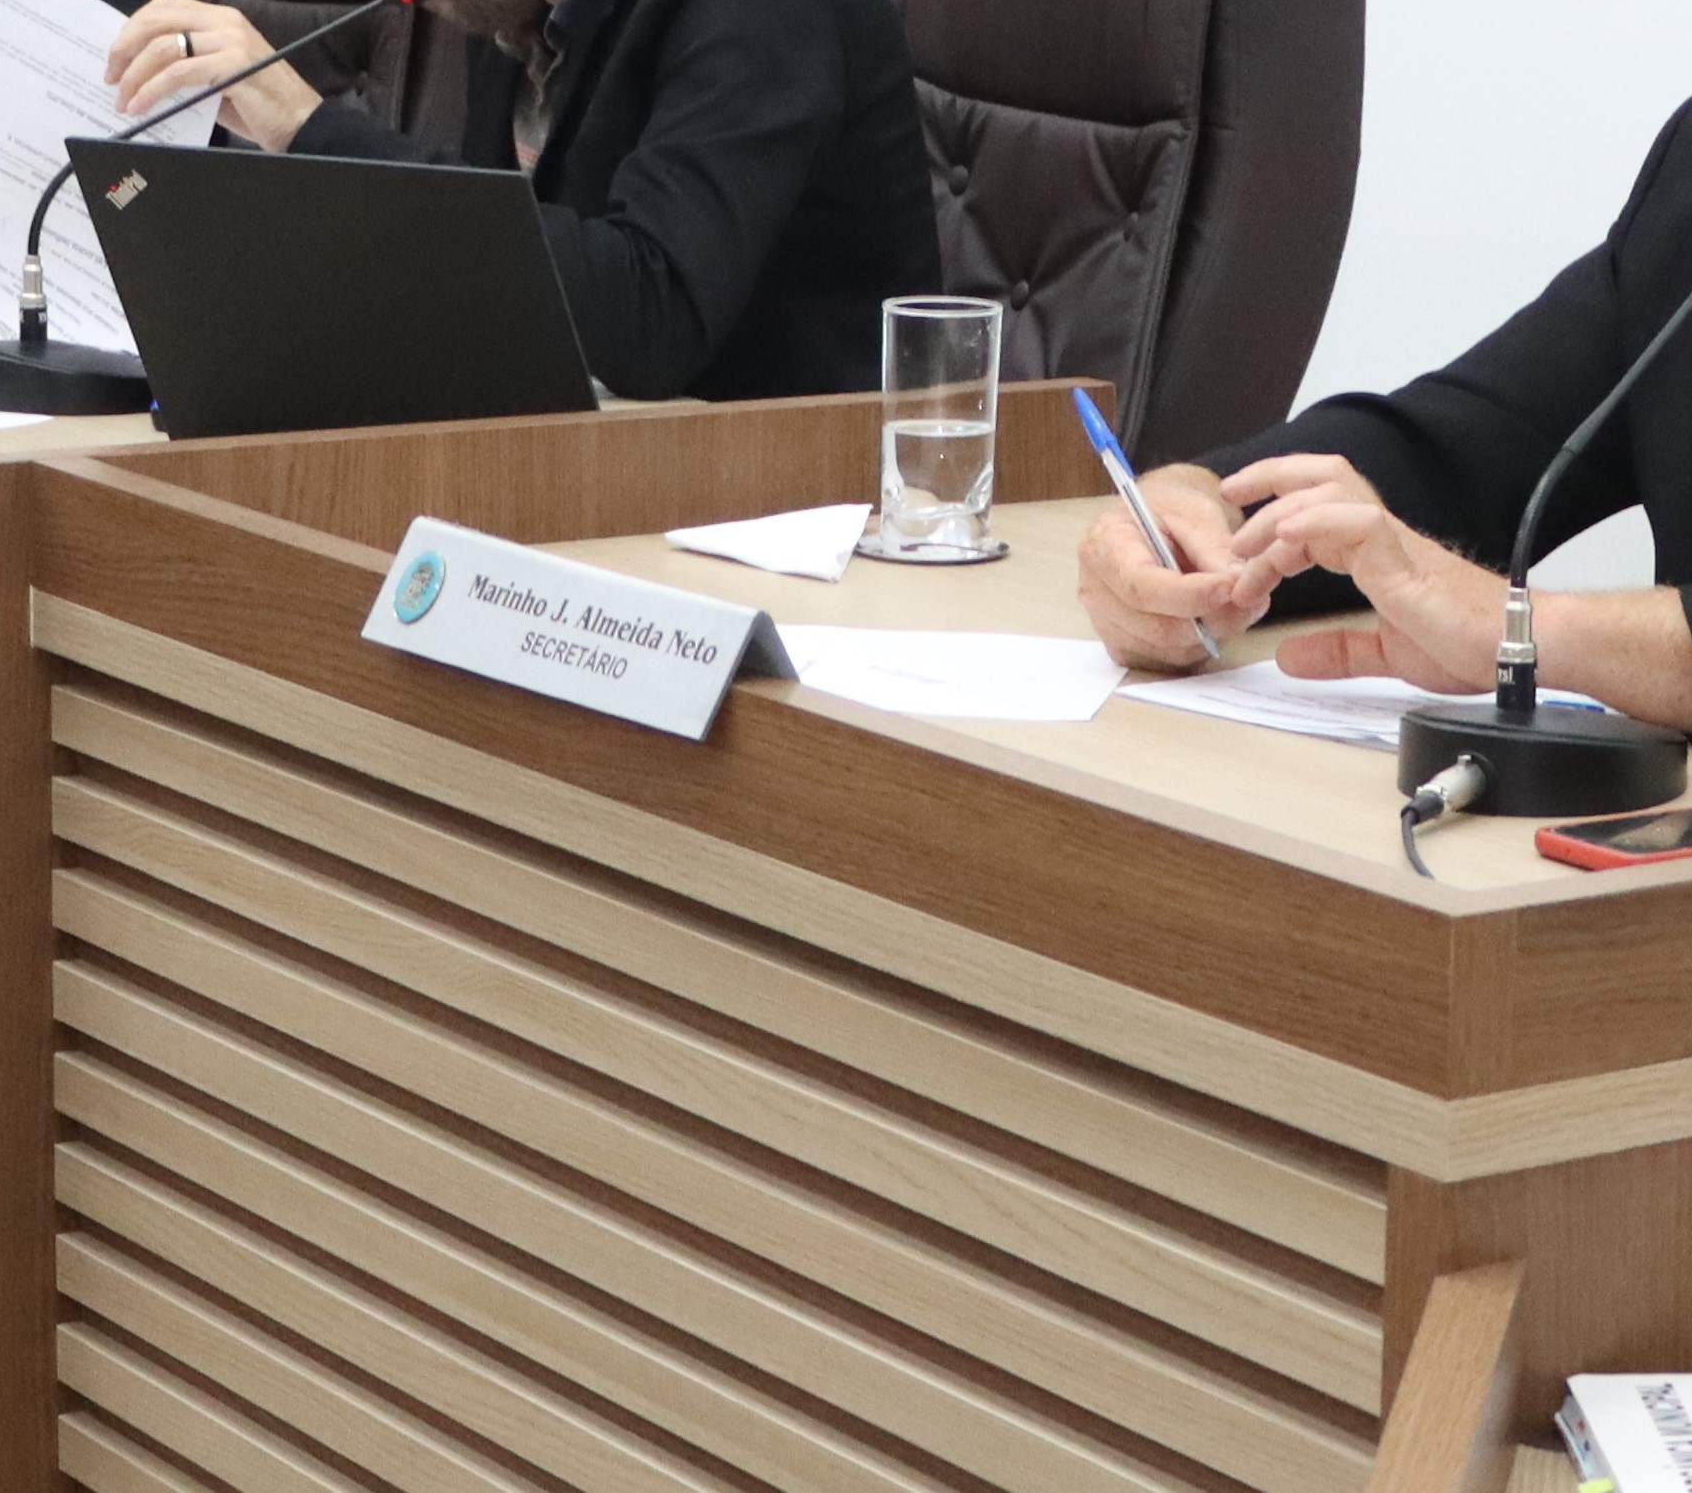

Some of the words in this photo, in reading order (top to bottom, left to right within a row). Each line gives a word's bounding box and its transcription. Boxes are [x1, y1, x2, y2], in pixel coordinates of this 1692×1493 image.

[105, 169, 148, 210] ThinkPad
[467, 573, 548, 617] Marinho
[550, 599, 569, 625] J.
[576, 605, 664, 650] Almeida
[667, 628, 719, 665] Neto
[520, 630, 628, 680] SECRETÁRIO
